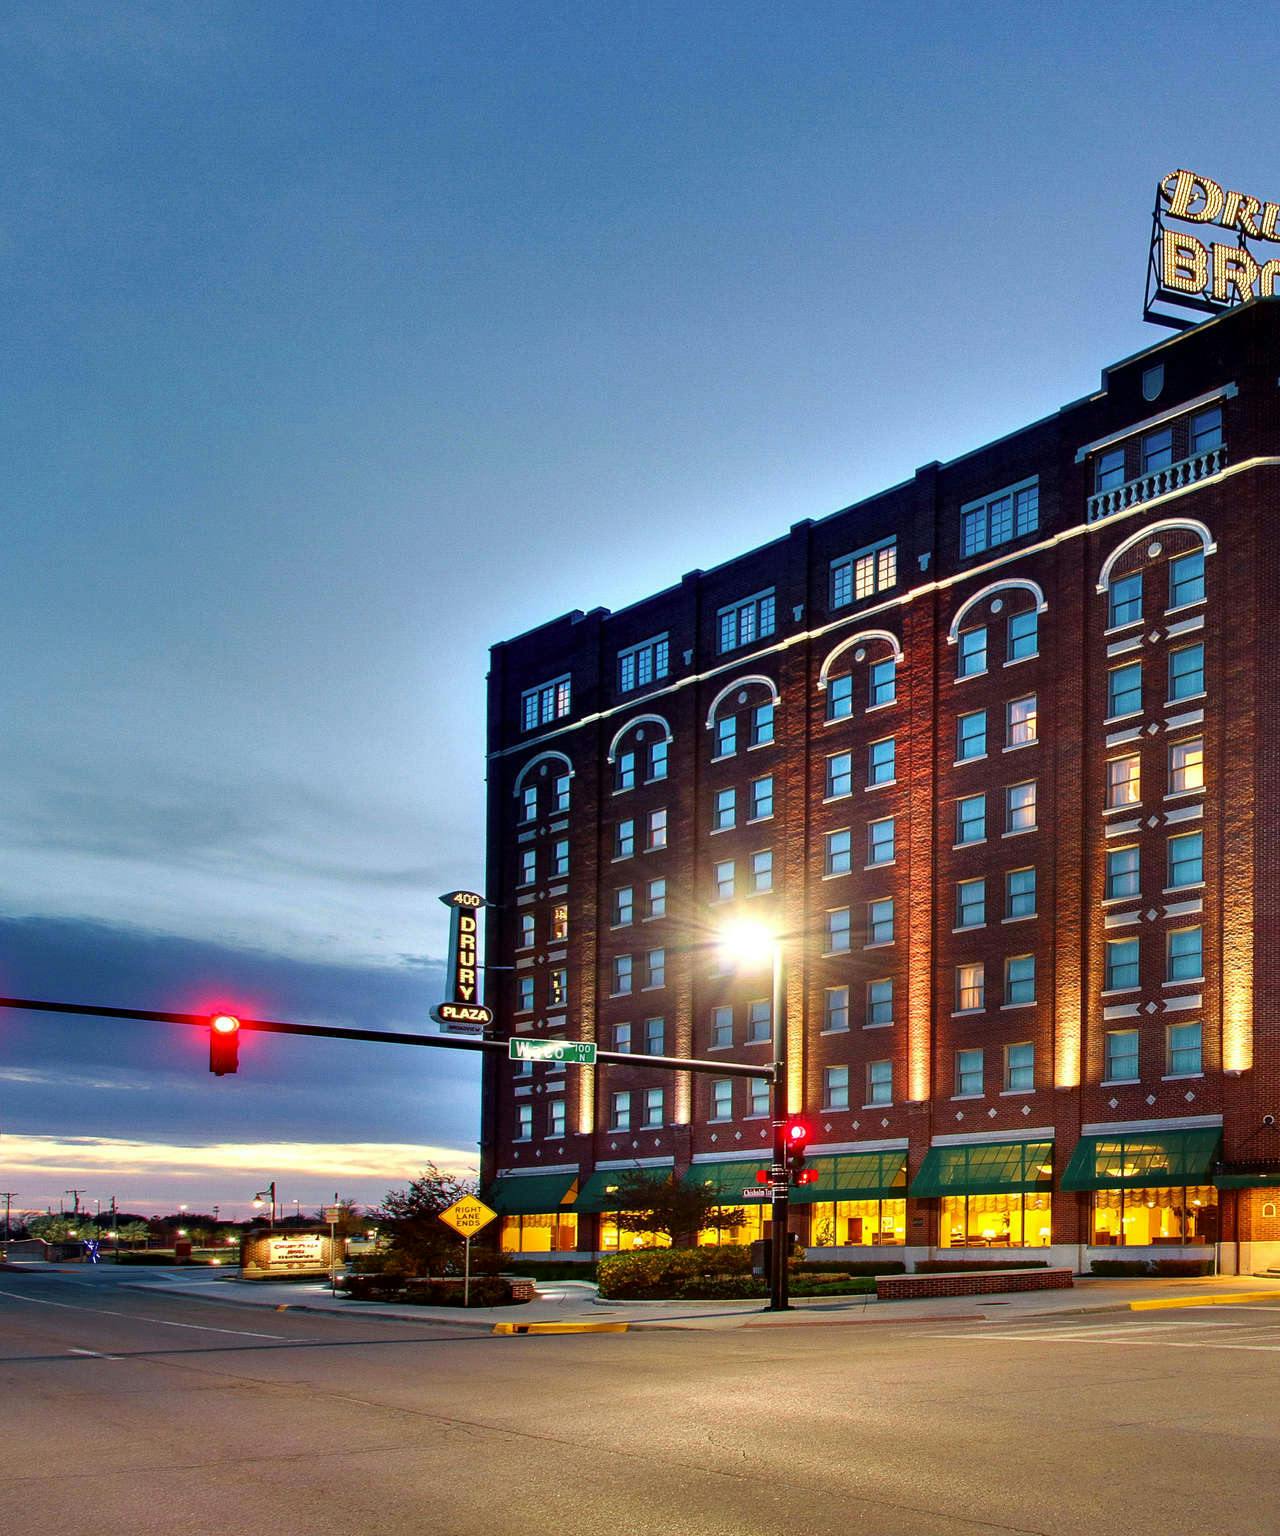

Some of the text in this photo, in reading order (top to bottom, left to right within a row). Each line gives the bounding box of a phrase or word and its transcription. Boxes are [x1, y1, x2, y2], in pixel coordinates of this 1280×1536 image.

[453, 893, 480, 906] 400
[459, 916, 477, 1001] DRURY
[443, 1006, 489, 1022] PLAZA
[575, 1044, 591, 1053] 100
[579, 1054, 586, 1062] N
